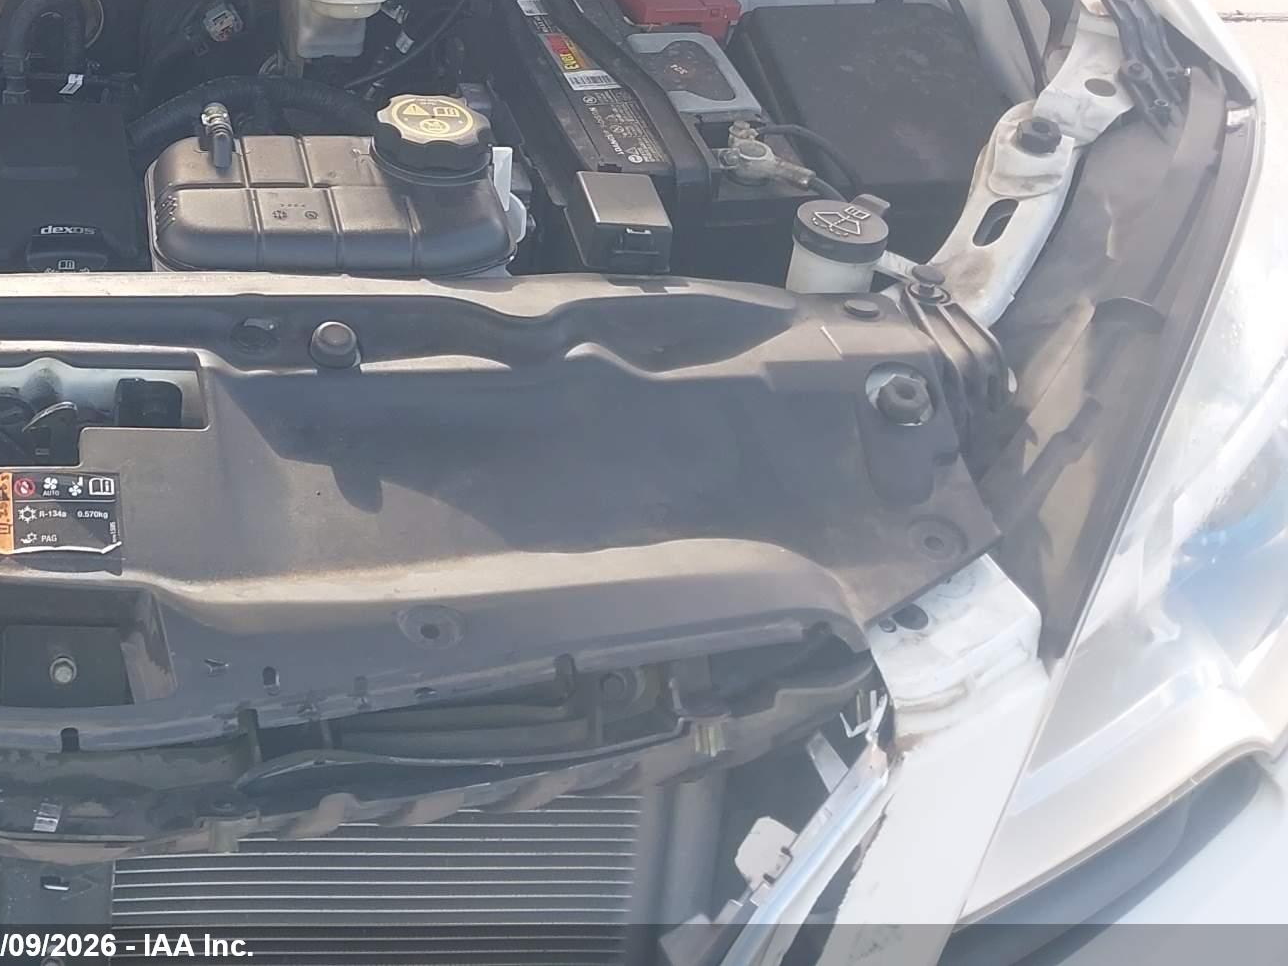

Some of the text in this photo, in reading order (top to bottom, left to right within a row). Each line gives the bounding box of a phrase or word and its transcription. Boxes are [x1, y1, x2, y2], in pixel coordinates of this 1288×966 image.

[40, 225, 96, 235] dexos
[39, 510, 67, 518] R-134a
[41, 534, 58, 542] PAG
